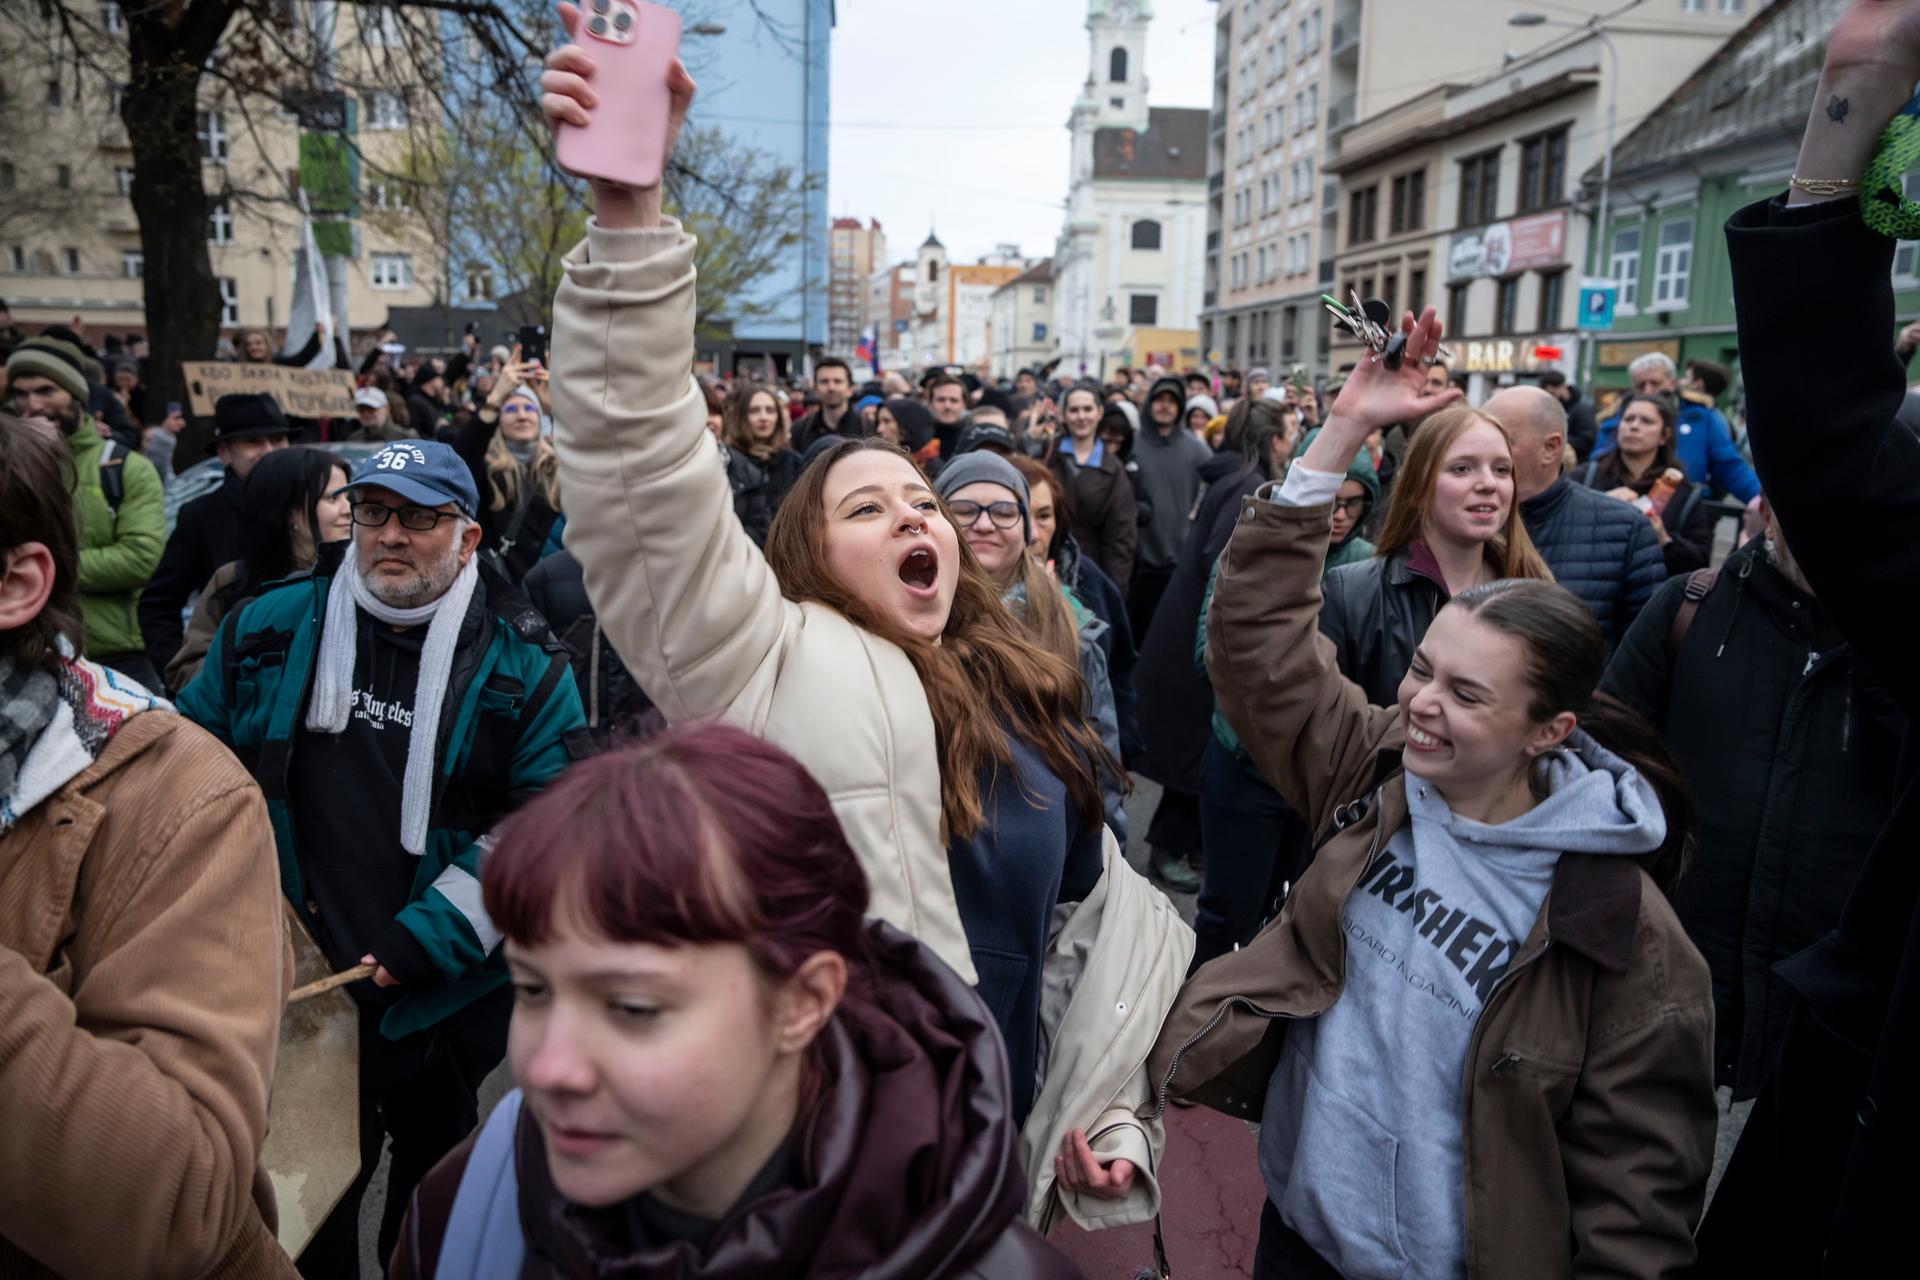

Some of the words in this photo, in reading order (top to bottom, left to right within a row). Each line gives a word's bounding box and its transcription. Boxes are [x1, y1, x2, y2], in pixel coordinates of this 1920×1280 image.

[1591, 293, 1604, 312] P
[1467, 340, 1513, 371] BAR
[376, 451, 410, 471] 36
